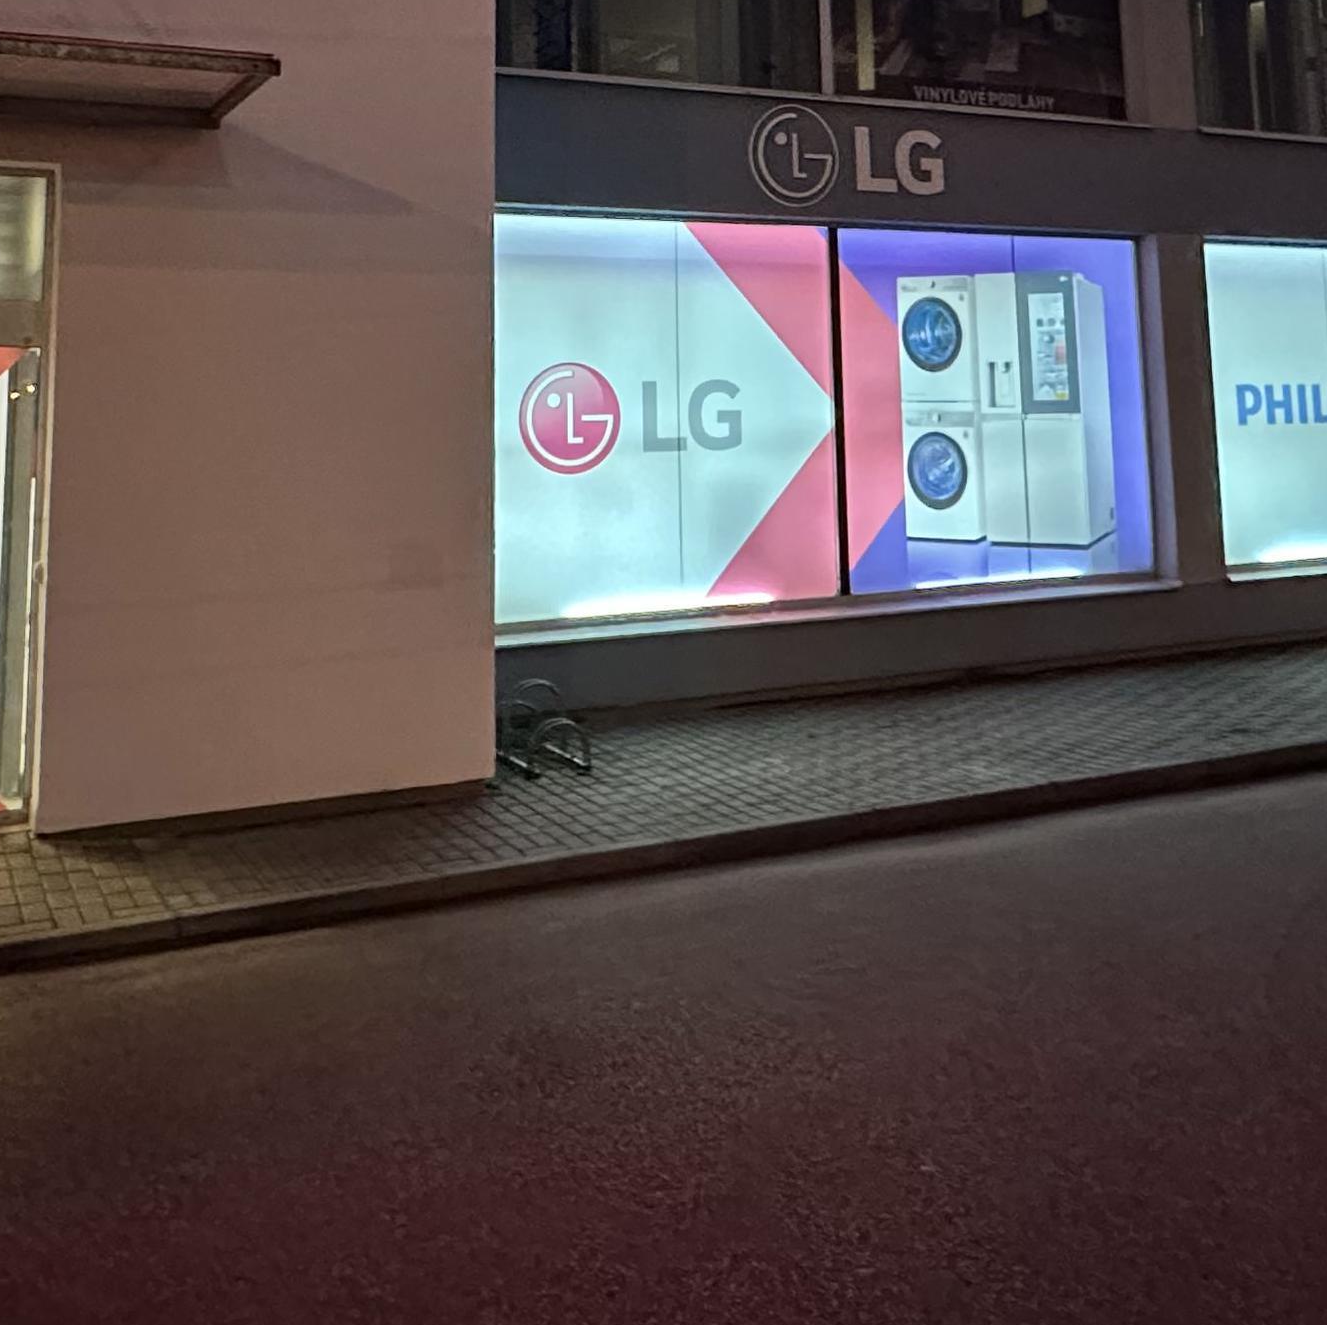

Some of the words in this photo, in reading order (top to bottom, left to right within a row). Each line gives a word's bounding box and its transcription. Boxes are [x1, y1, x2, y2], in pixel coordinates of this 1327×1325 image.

[987, 92, 1056, 111] PODLAHY
[855, 125, 944, 194] LG
[642, 379, 743, 453] LG
